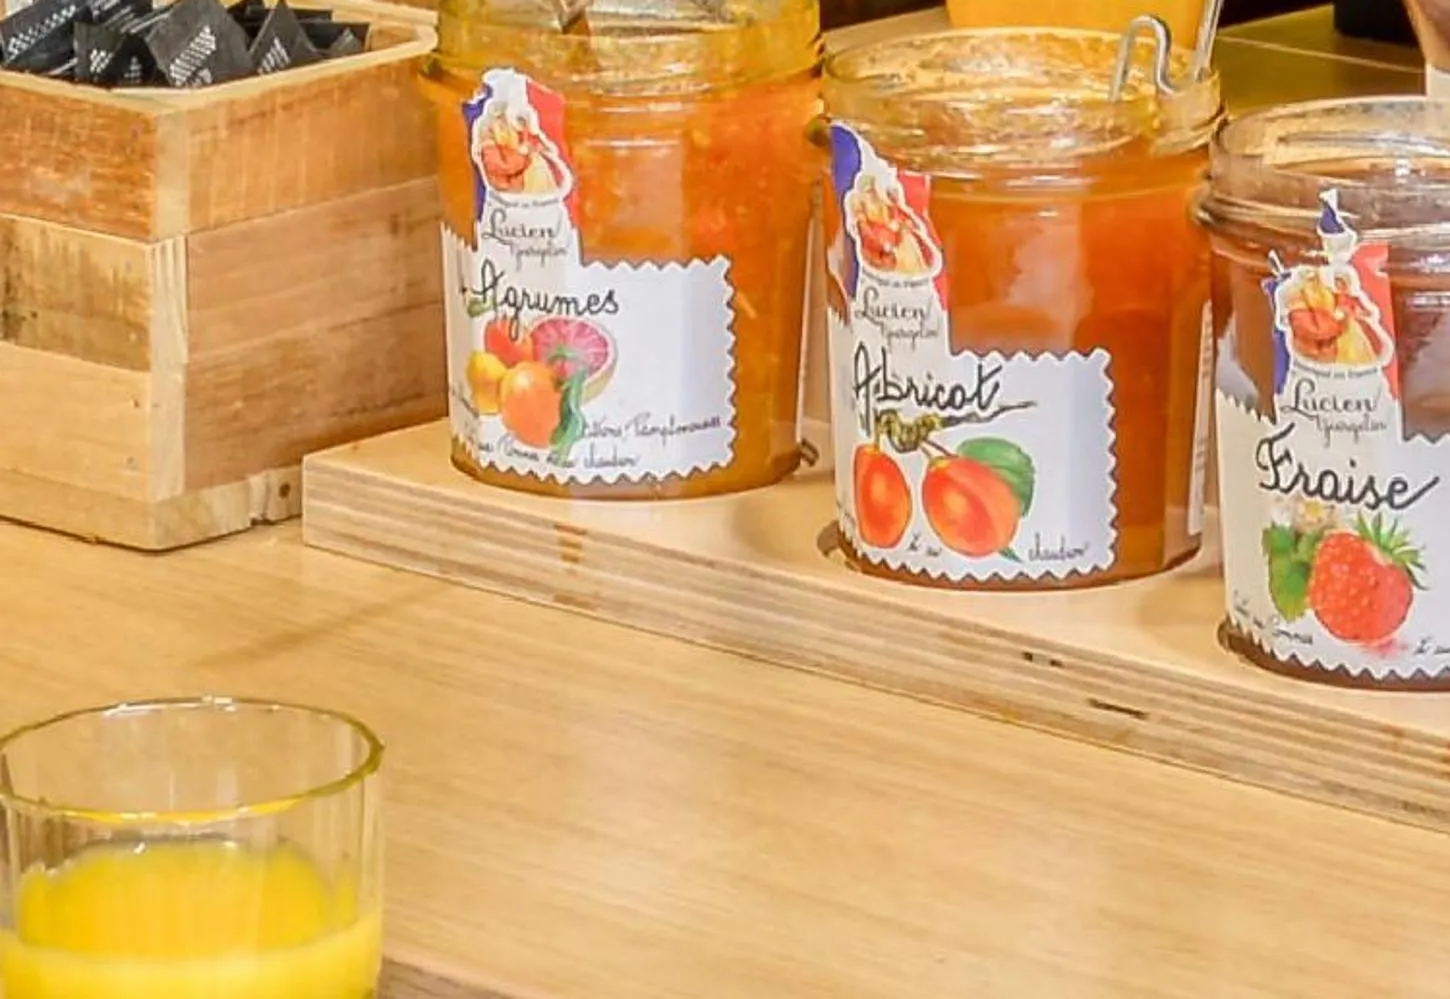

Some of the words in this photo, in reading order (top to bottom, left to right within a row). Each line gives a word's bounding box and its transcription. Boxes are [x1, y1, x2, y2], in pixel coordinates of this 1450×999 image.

[466, 257, 620, 342] Agrumes
[852, 340, 1003, 436] Abricot
[1280, 378, 1382, 420] Lucien
[1255, 421, 1441, 511] Fraise
